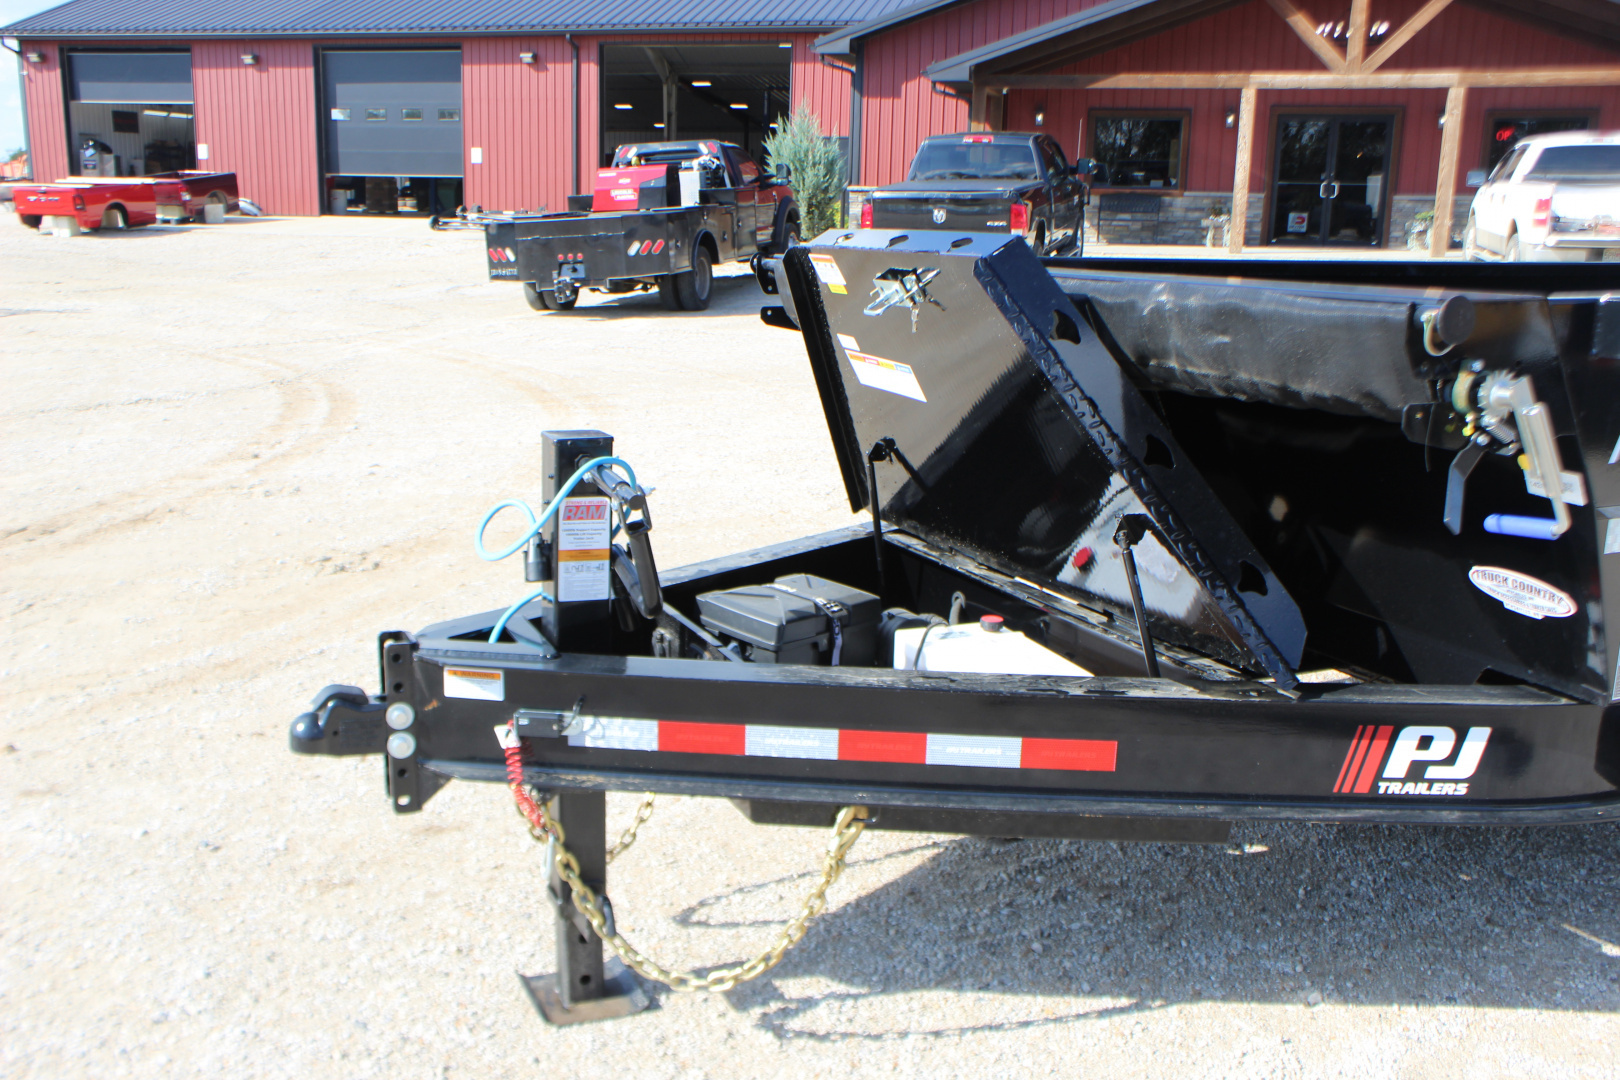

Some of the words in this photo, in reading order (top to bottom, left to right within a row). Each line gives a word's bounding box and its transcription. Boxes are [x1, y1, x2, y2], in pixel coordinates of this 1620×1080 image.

[562, 505, 607, 520] RAM
[1475, 571, 1509, 586] TRUCK
[1511, 578, 1564, 605] COUNTRY
[460, 671, 495, 679] WARNING
[1382, 726, 1492, 779] PJ
[1378, 781, 1470, 796] TRAILERS
